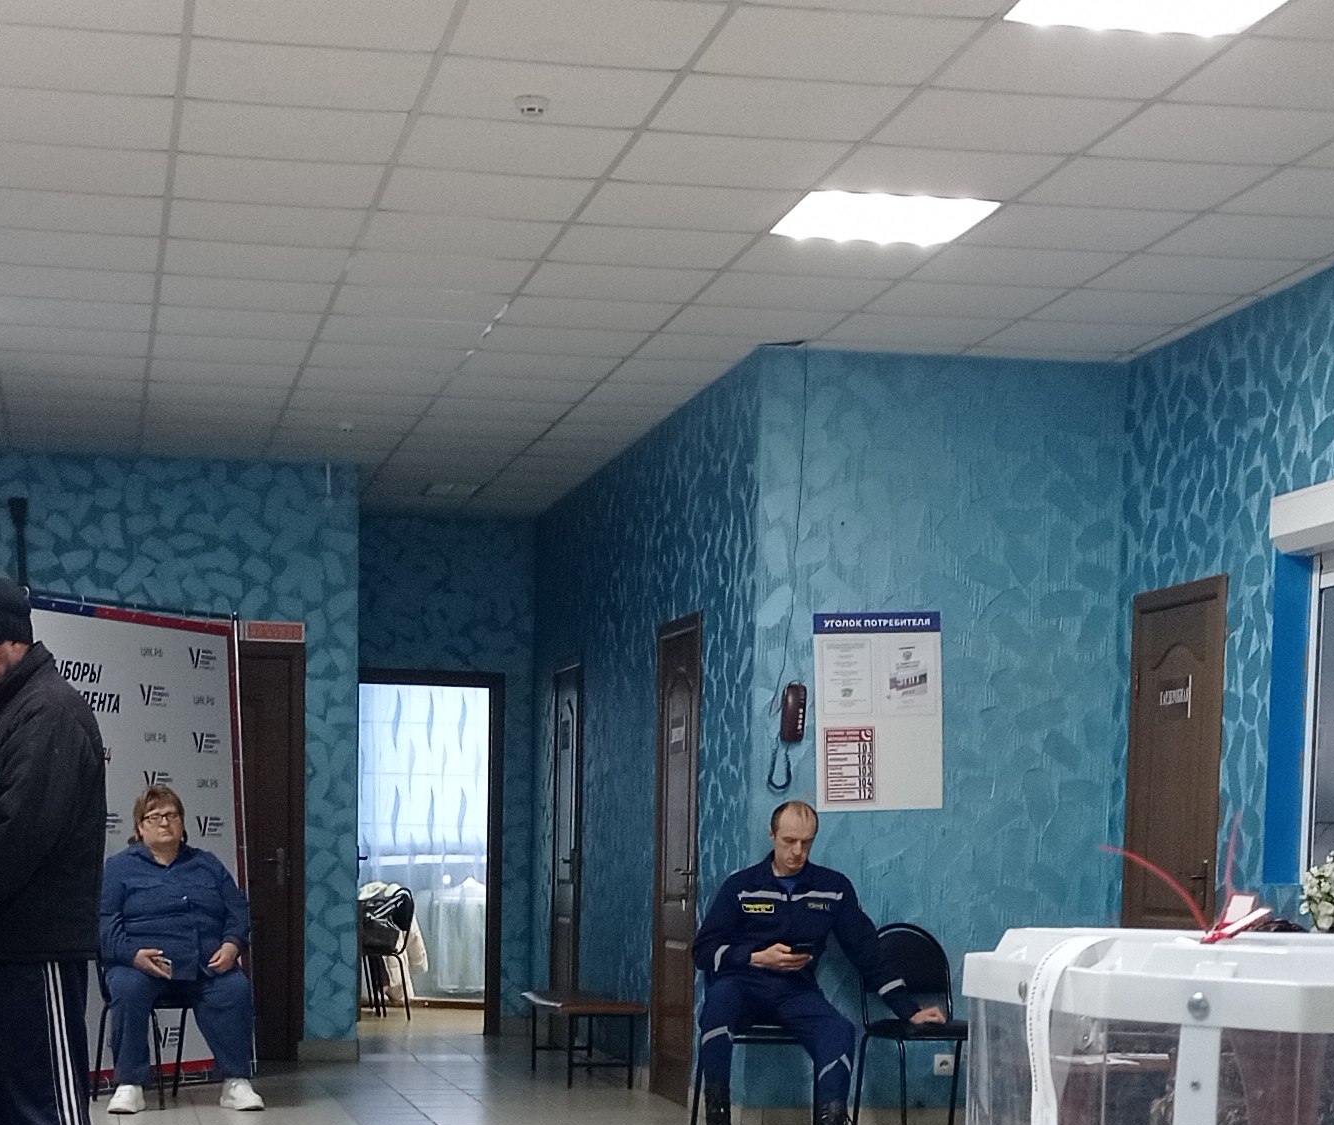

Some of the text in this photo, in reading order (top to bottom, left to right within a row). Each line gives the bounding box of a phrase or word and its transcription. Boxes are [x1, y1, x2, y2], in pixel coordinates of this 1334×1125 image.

[824, 617, 931, 628] УГОЛОК ПОТРЕБИТЕЛЯ
[858, 742, 872, 754] 101
[858, 754, 872, 765] 102
[858, 765, 872, 776] 103
[858, 777, 873, 788] 104
[858, 788, 873, 800] 112
